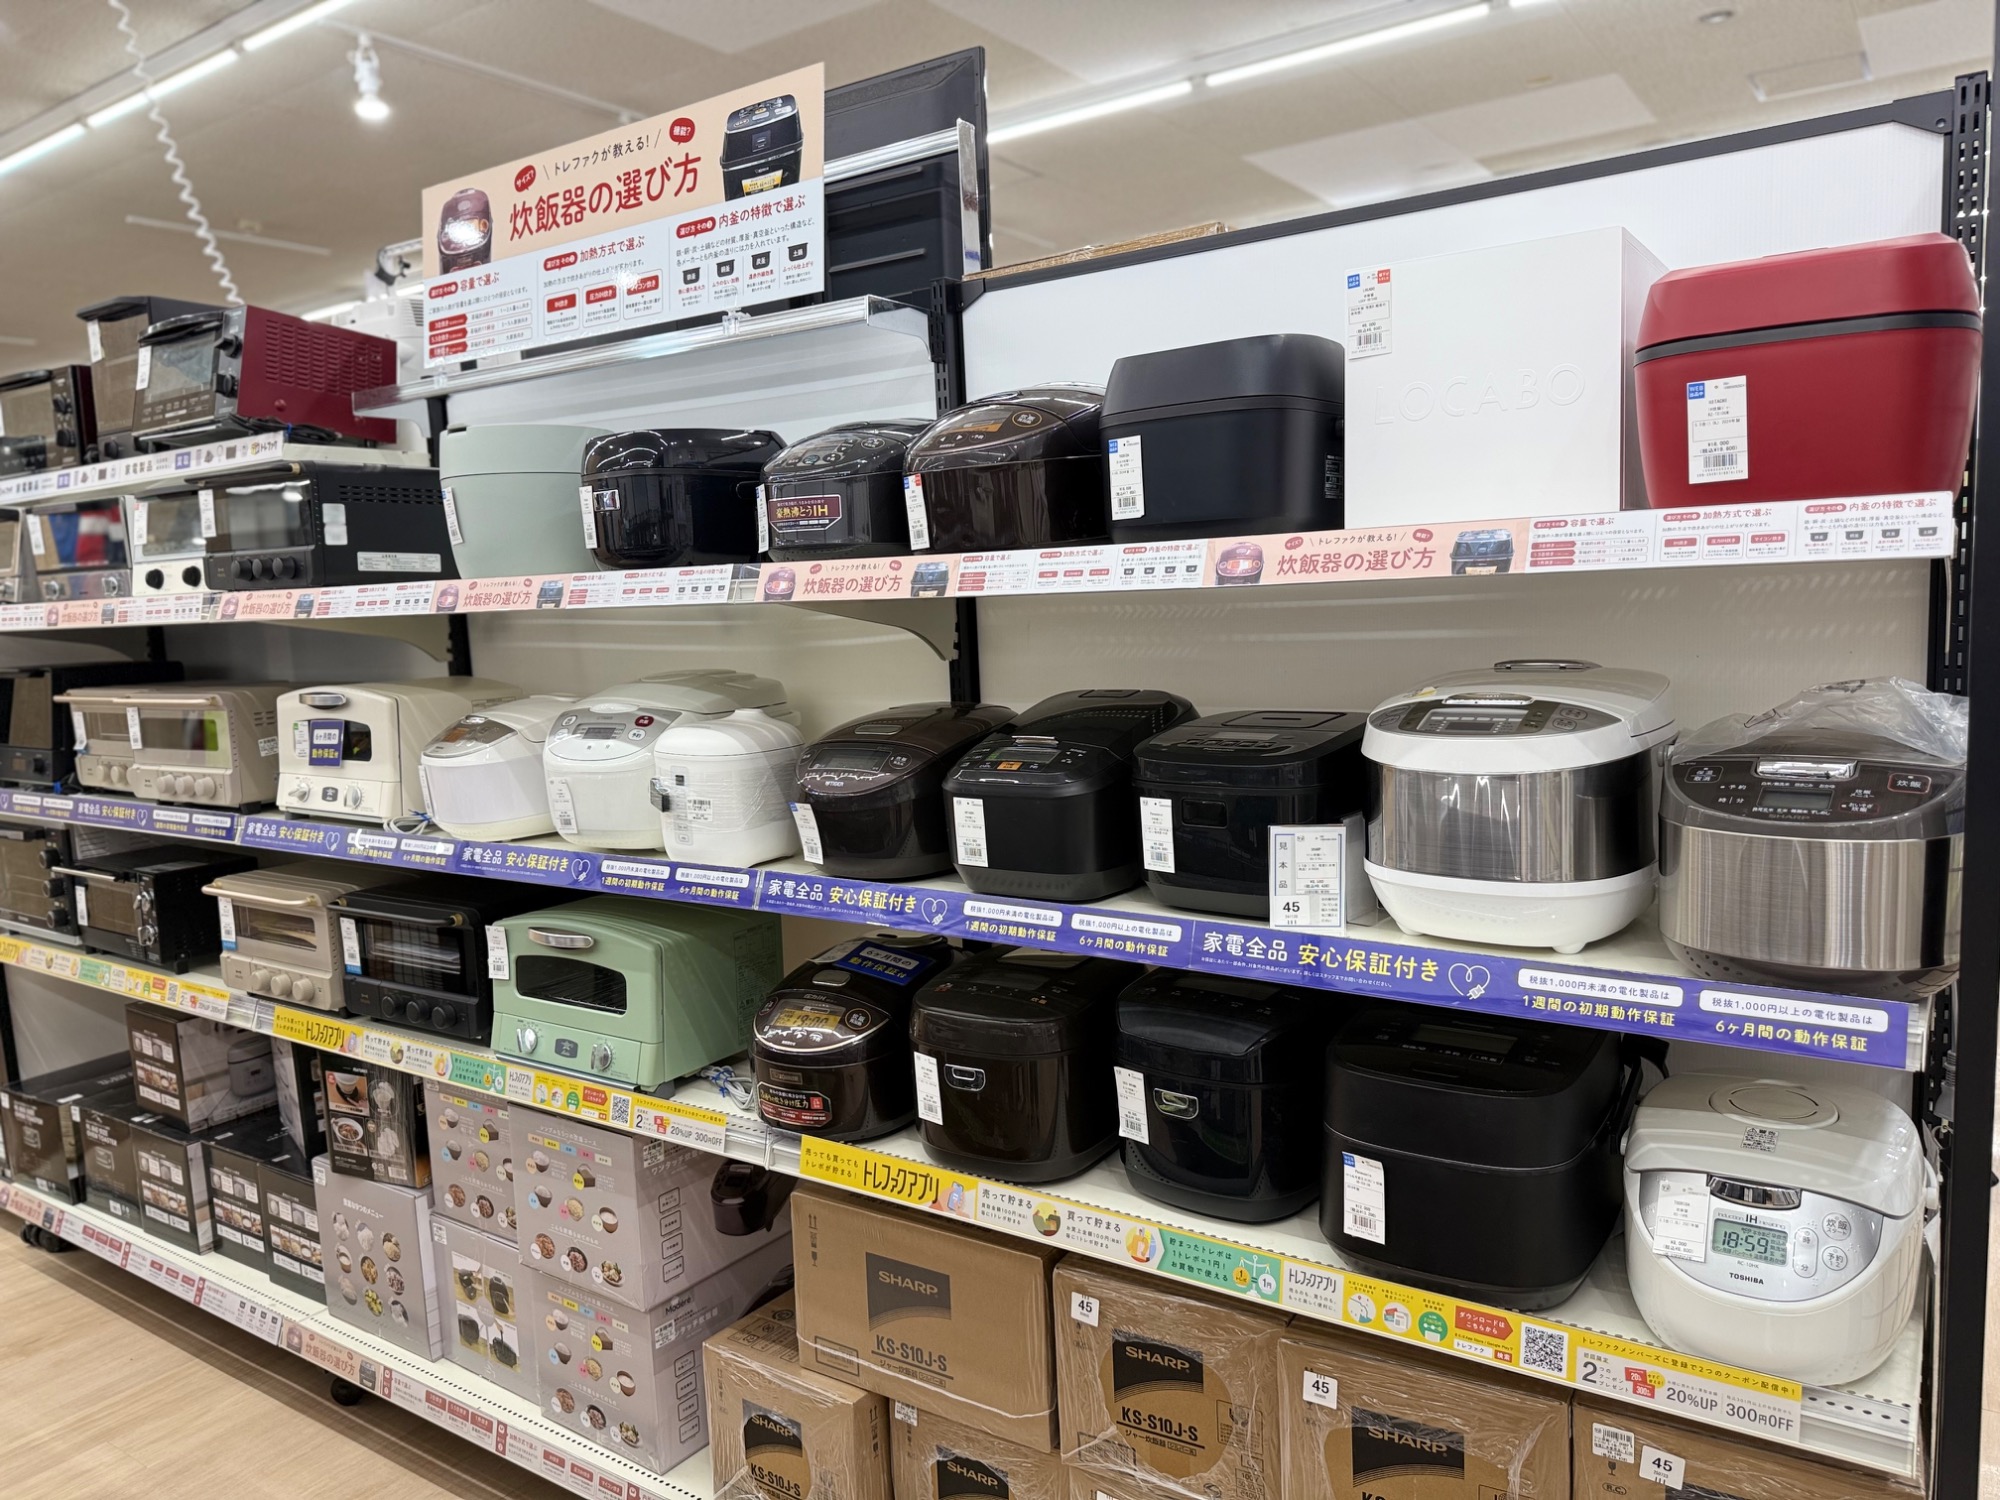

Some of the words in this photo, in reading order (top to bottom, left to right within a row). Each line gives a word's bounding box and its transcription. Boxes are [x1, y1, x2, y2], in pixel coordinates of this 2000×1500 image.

[510, 152, 701, 241] 炊飯器の選び方
[719, 195, 806, 229] 内釜の特徴で選ぶ
[580, 236, 645, 262] 加熱方式で選ぶ
[460, 272, 500, 291] 容量で選ぶ
[1374, 363, 1587, 426] LOCABO
[1703, 508, 1772, 520] 加熱方式で選ぶ
[1849, 498, 1937, 511] 内釜の特徴で選ぶ
[1570, 517, 1615, 528] 容量で選ぶ
[1277, 547, 1437, 576] 炊飯器の選び方
[803, 575, 902, 594] 炊飯器の選び方
[240, 602, 291, 616] 炊飯器の選び方
[463, 590, 532, 608] 炊飯器の選び方
[1896, 779, 1922, 789] 炊飯
[247, 822, 276, 837] 家電全品
[279, 828, 324, 843] 安心保証付き
[462, 847, 501, 865] 家電全品
[505, 852, 568, 872] 安心保証付き
[1278, 842, 1288, 889] 見本品
[602, 877, 665, 892] 1週間の初期動作保証
[768, 879, 823, 901] 家電全品
[829, 886, 917, 913] 安心保証付き
[1283, 901, 1300, 912] 45
[970, 905, 1054, 922] 税抜1,000円未満の電化製品は
[965, 922, 1056, 942] 1週間の初期動作保証
[1079, 919, 1173, 937] 税抜1,000円以上の電化製品は
[1202, 932, 1288, 962] 家電全品
[1298, 944, 1439, 982] 安心保証付き
[1529, 975, 1670, 1000] 税抜1,000円未満の電化製品は
[1522, 995, 1676, 1027] 1週間の初期動作保証
[1712, 998, 1873, 1025] 税抜1,000円以上の電化製品は
[306, 1020, 344, 1048] トレファクアプリ
[365, 1034, 390, 1047] 売って貯まる
[406, 1045, 433, 1058] 買って貯まる
[636, 1114, 643, 1129] 2
[670, 1125, 693, 1139] 20%UP
[695, 1131, 723, 1147] 300円OFF
[805, 1147, 859, 1168] 売っても買っても
[864, 1160, 940, 1204] トレファクアプリ
[982, 1188, 1033, 1209] 売って貯まる
[1067, 1210, 1121, 1232] 買って貯まる
[1718, 1212, 1744, 1220] Induction
[1746, 1214, 1757, 1224] IH
[1826, 1219, 1848, 1230] 炊飯
[1722, 1230, 1769, 1254] 18:59
[1826, 1227, 1848, 1236] スタート
[1169, 1237, 1232, 1260] 貯まったトレポは
[1827, 1253, 1843, 1263] 予約
[1171, 1261, 1228, 1282] お買物で使える
[1289, 1268, 1336, 1293] トレファクアプリ
[1729, 1272, 1764, 1285] TOSHIBA
[878, 1270, 938, 1296] SHARP
[1261, 1278, 1273, 1289] 1円
[1077, 1301, 1093, 1314] 45
[1459, 1311, 1505, 1328] ダウンロードは
[1466, 1322, 1498, 1335] こちらから
[875, 1333, 947, 1372] KS-S10J-S
[1125, 1345, 1190, 1371] SHARP
[1457, 1342, 1484, 1353] トレファク
[1497, 1352, 1511, 1360] 検索
[305, 1342, 355, 1377] 炊飯器の選び方
[880, 1359, 918, 1379] ジャー炊飯器
[1582, 1336, 1796, 1396] トレファクメンバーズに登録で2つのクーポン配信中!
[1599, 1366, 1611, 1374] つの
[1582, 1361, 1597, 1384] 2
[1599, 1373, 1623, 1384] クーポン
[1311, 1379, 1330, 1395] 45
[1599, 1380, 1630, 1393] プレゼント
[1666, 1387, 1718, 1412] 20%UP
[751, 1414, 794, 1438] SHARP
[1121, 1406, 1198, 1442] KS-S10J-S
[1726, 1403, 1794, 1432] 300円OFF
[1125, 1429, 1167, 1449] ジャー炊飯器
[1367, 1425, 1447, 1455] SHARP
[947, 1461, 998, 1486] SHARP
[1652, 1457, 1673, 1472] 45
[750, 1462, 801, 1496] KS-S10J-S
